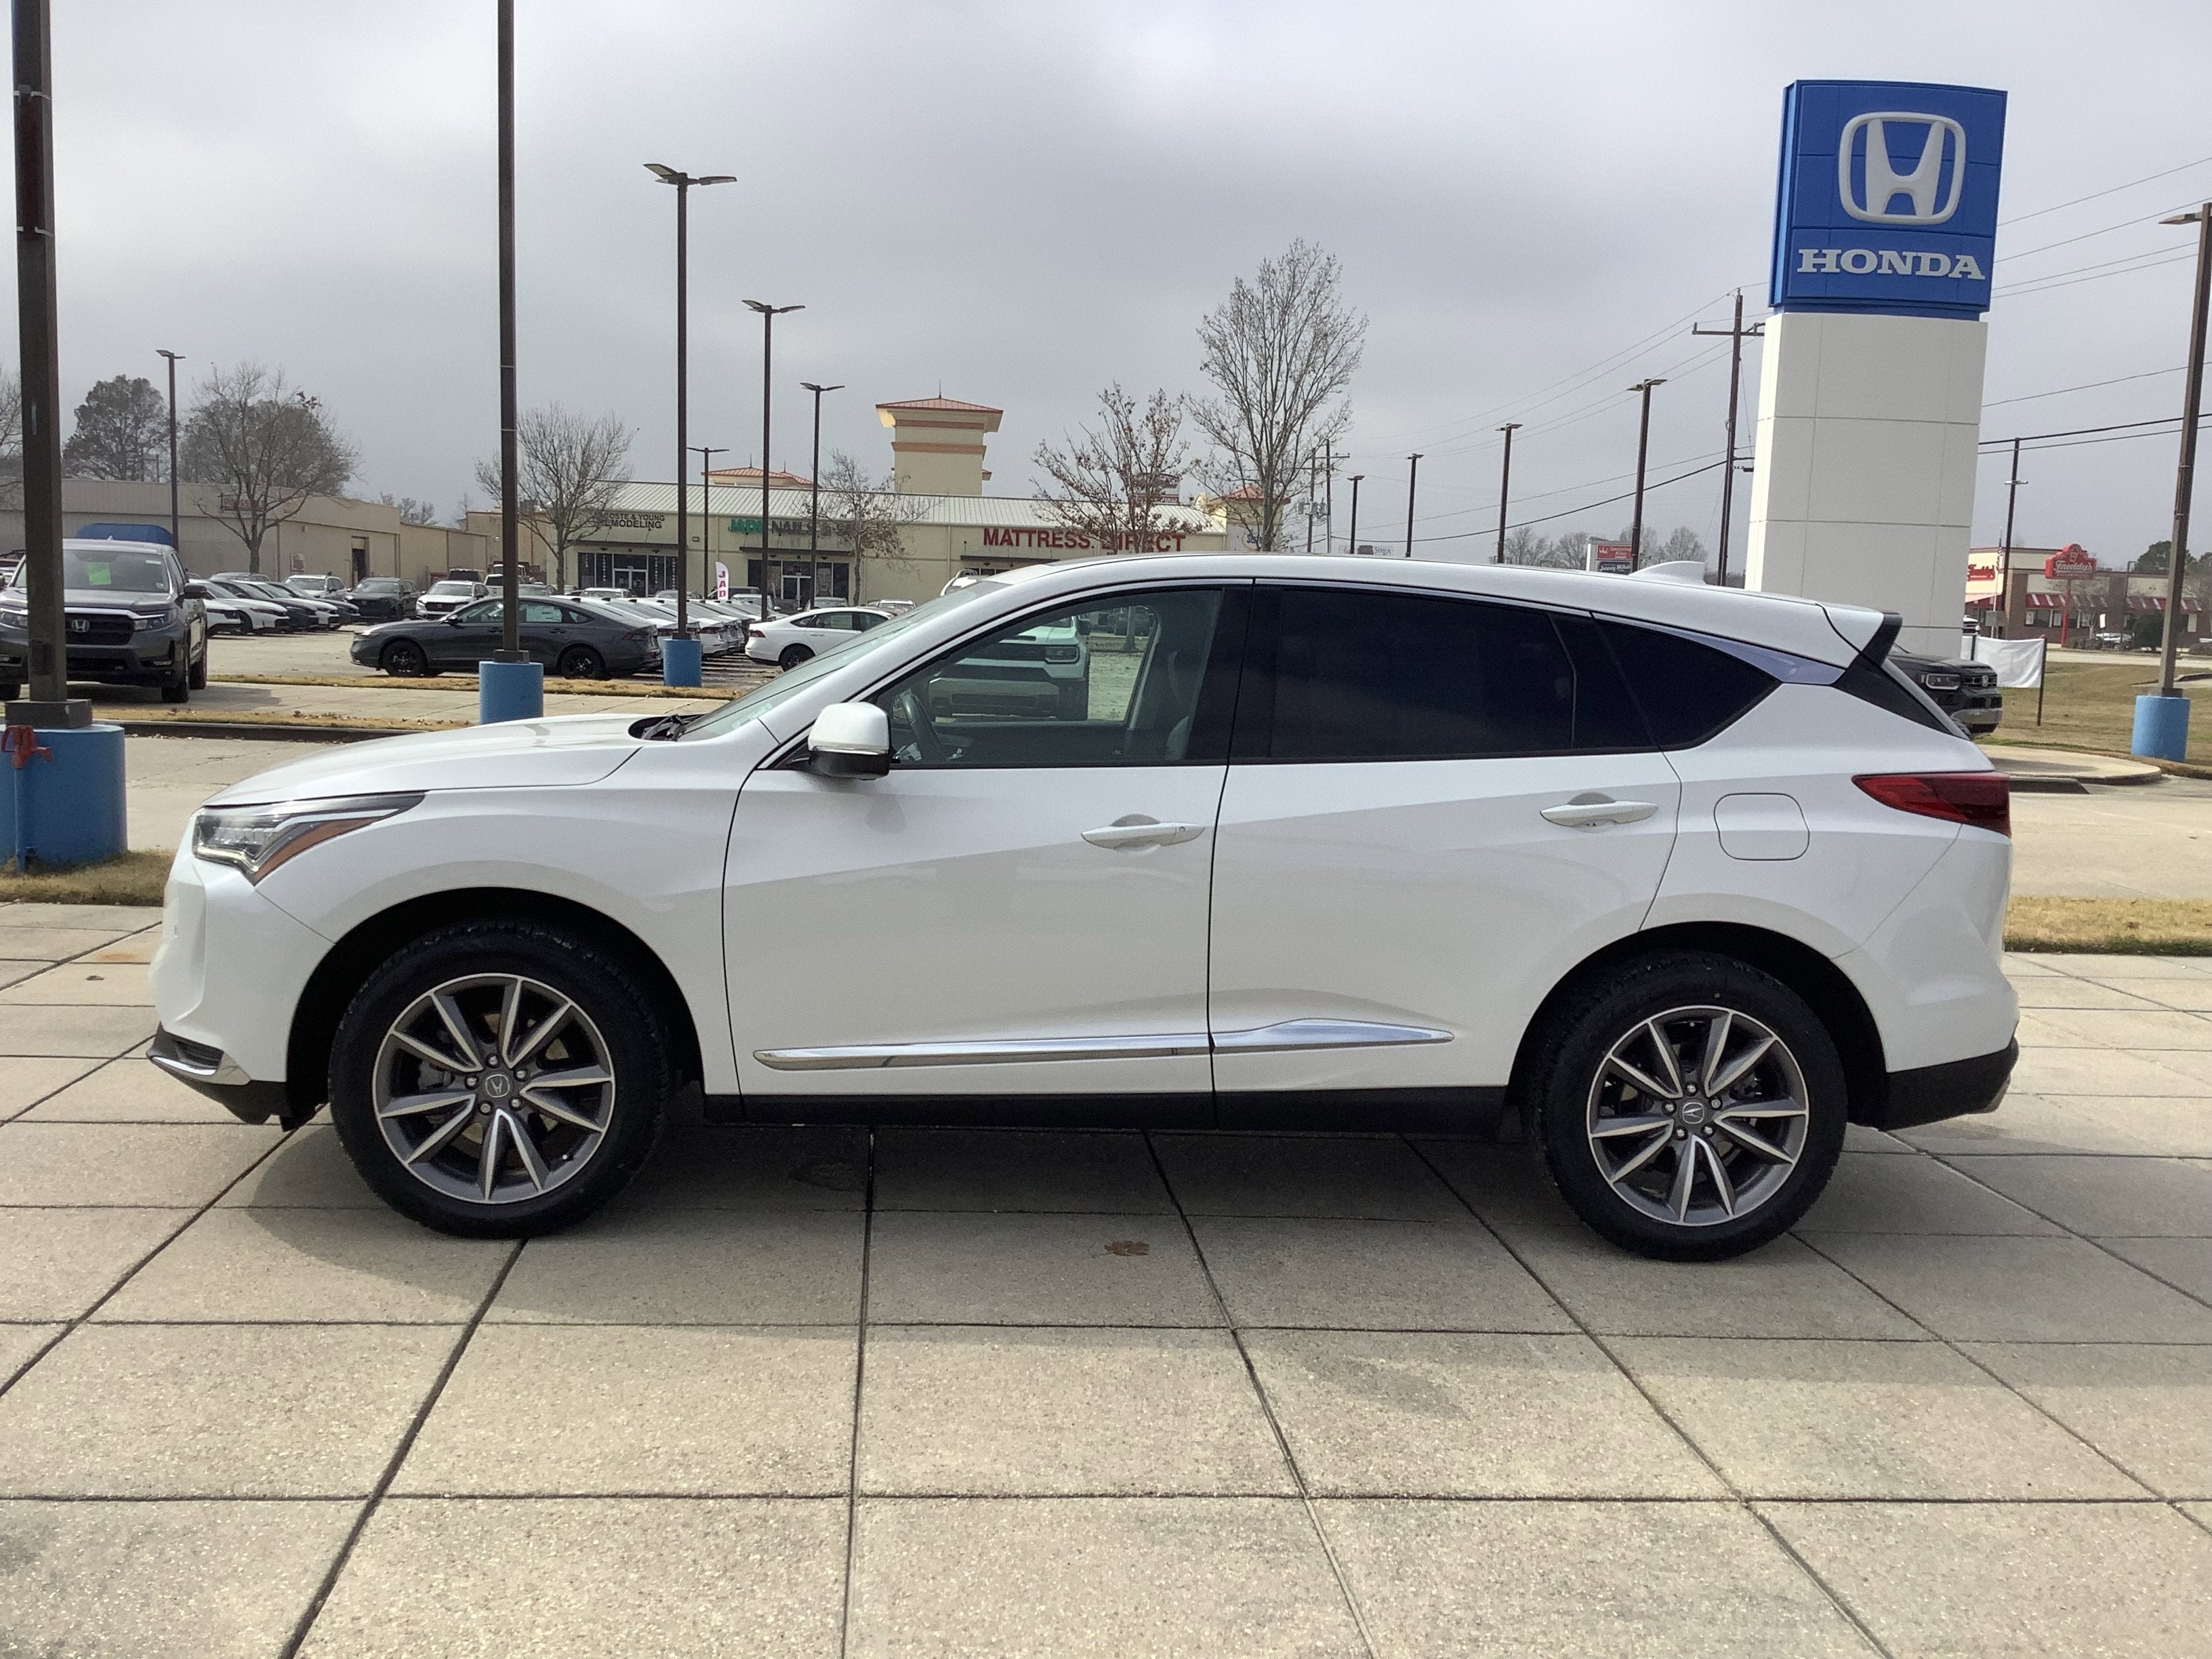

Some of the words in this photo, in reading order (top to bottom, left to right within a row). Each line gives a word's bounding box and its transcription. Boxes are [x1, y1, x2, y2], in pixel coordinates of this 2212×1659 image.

[1797, 248, 1986, 281] HONDA
[983, 527, 1090, 549] MATTRESS
[2053, 560, 2093, 571] Freddy's
[718, 571, 726, 597] JAD
